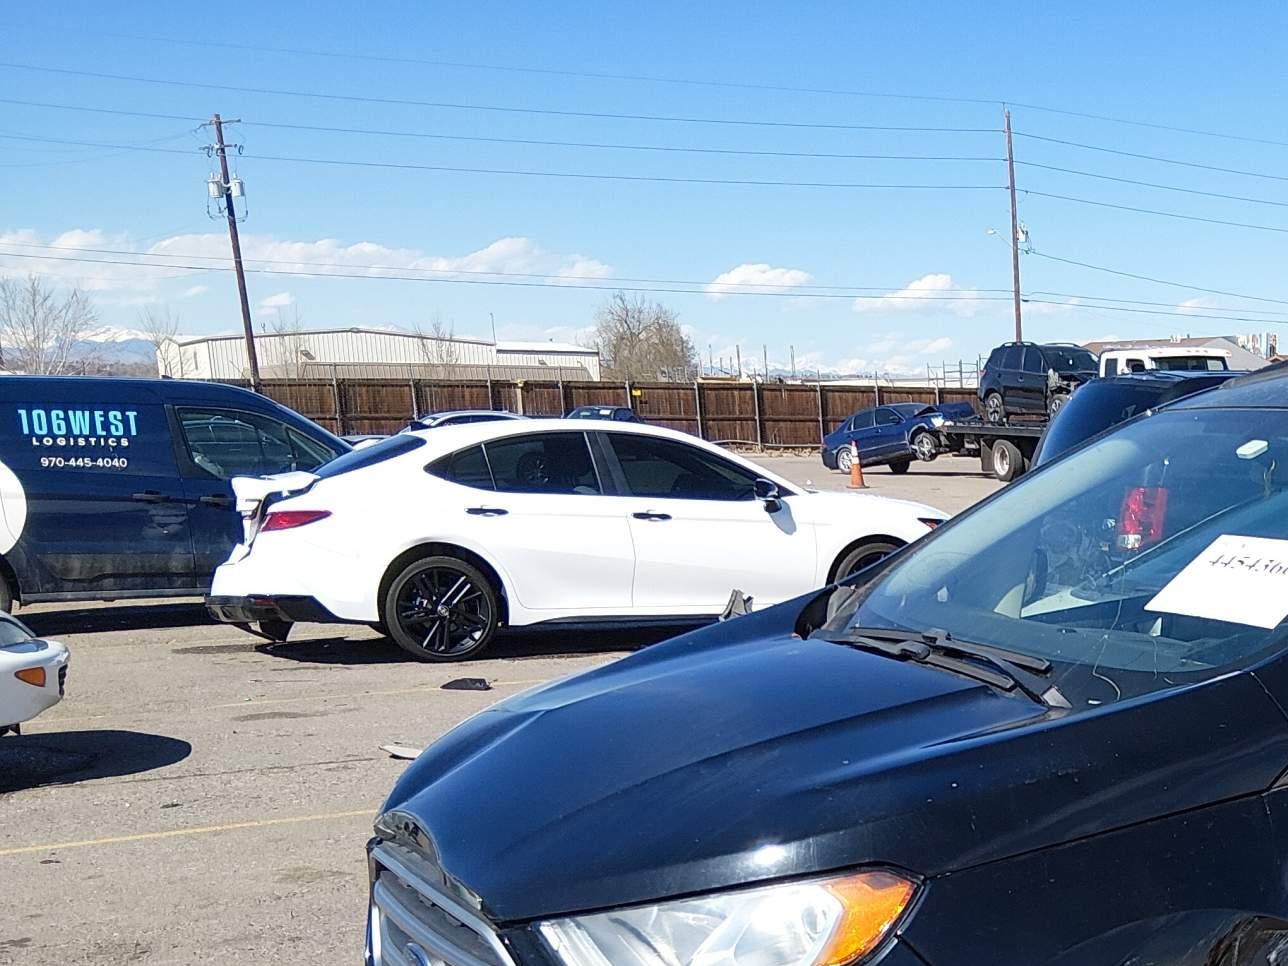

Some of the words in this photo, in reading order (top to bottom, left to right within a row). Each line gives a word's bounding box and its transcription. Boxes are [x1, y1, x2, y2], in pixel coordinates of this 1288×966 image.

[18, 408, 138, 436] 106WEST
[32, 437, 129, 447] LOGISTICS
[40, 456, 128, 469] 970-445-4040
